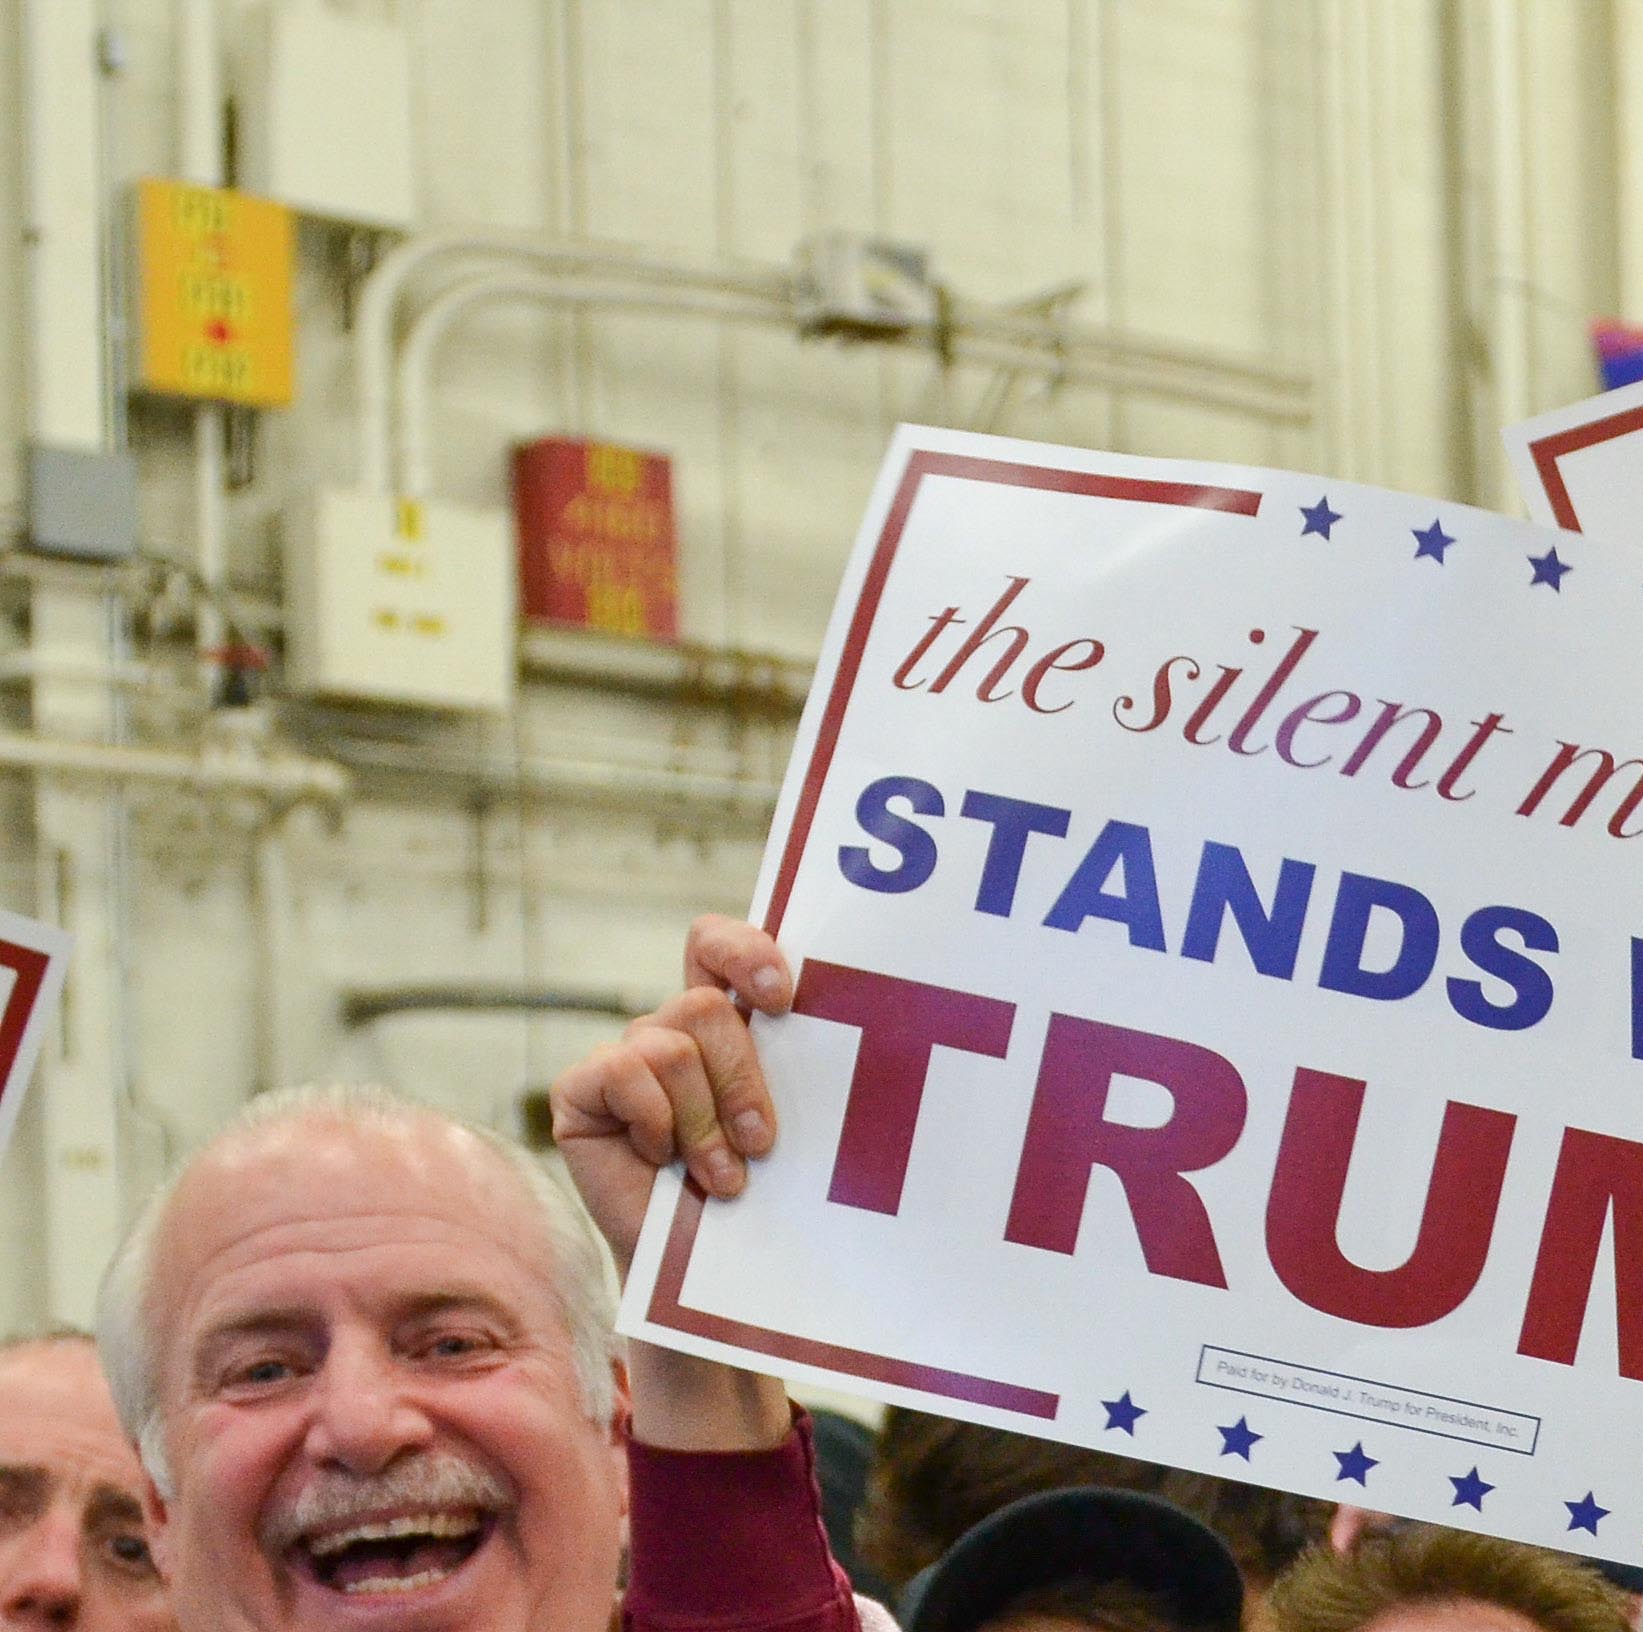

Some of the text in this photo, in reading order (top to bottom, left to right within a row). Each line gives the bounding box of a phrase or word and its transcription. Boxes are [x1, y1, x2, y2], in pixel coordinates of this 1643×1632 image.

[892, 576, 1106, 713] the
[1112, 625, 1505, 802] silent
[837, 775, 1560, 1030] STANDS
[1217, 1360, 1247, 1379] Paid
[1250, 1367, 1269, 1382] for
[1272, 1371, 1288, 1391] by
[1291, 1376, 1340, 1398] Donald
[1359, 1390, 1401, 1414] Trump
[1404, 1400, 1423, 1415] for
[1495, 1421, 1520, 1438] Inc.
